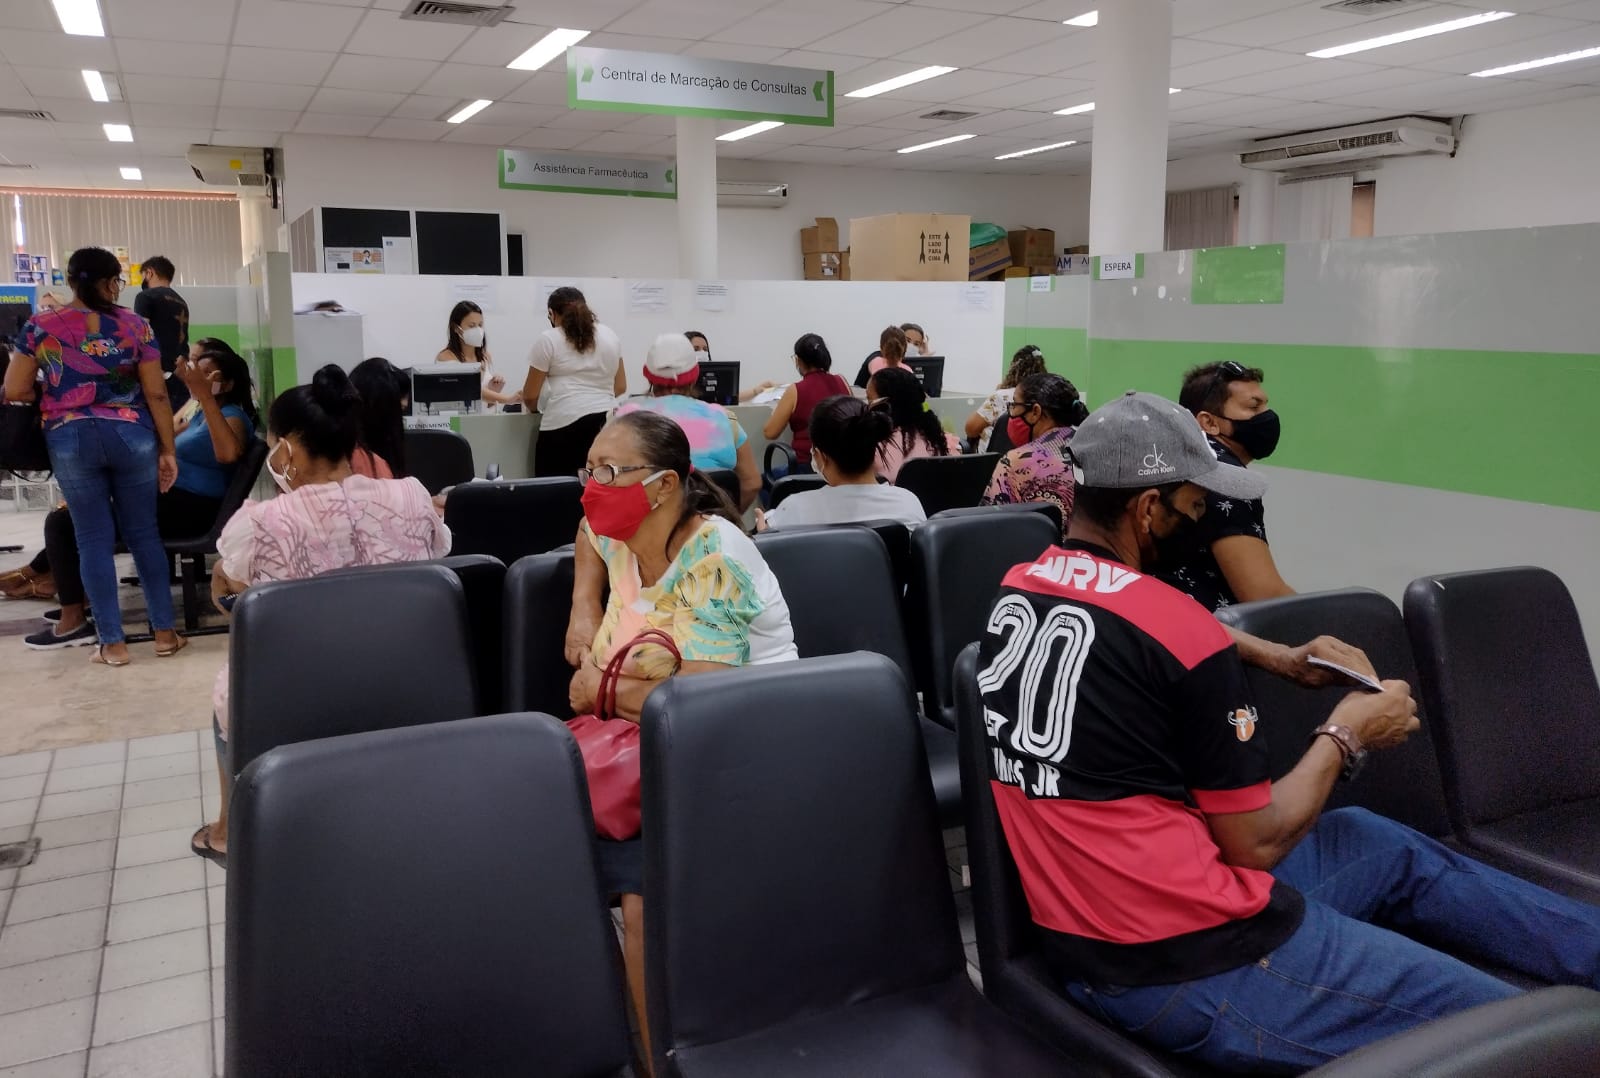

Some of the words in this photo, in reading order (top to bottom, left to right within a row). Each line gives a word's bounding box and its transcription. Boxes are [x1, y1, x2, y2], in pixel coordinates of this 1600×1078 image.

[601, 66, 647, 82] Central
[650, 71, 667, 84] de
[670, 72, 729, 90] Marcação
[733, 77, 748, 91] de
[751, 79, 807, 96] Consultas
[533, 162, 586, 175] Assistência
[588, 166, 649, 179] Farmacêutica
[1104, 262, 1132, 272] ESPERA
[1143, 443, 1168, 468] ck
[1137, 468, 1160, 476] Calvin
[976, 593, 1096, 763] 20
[1031, 761, 1061, 797] JR
